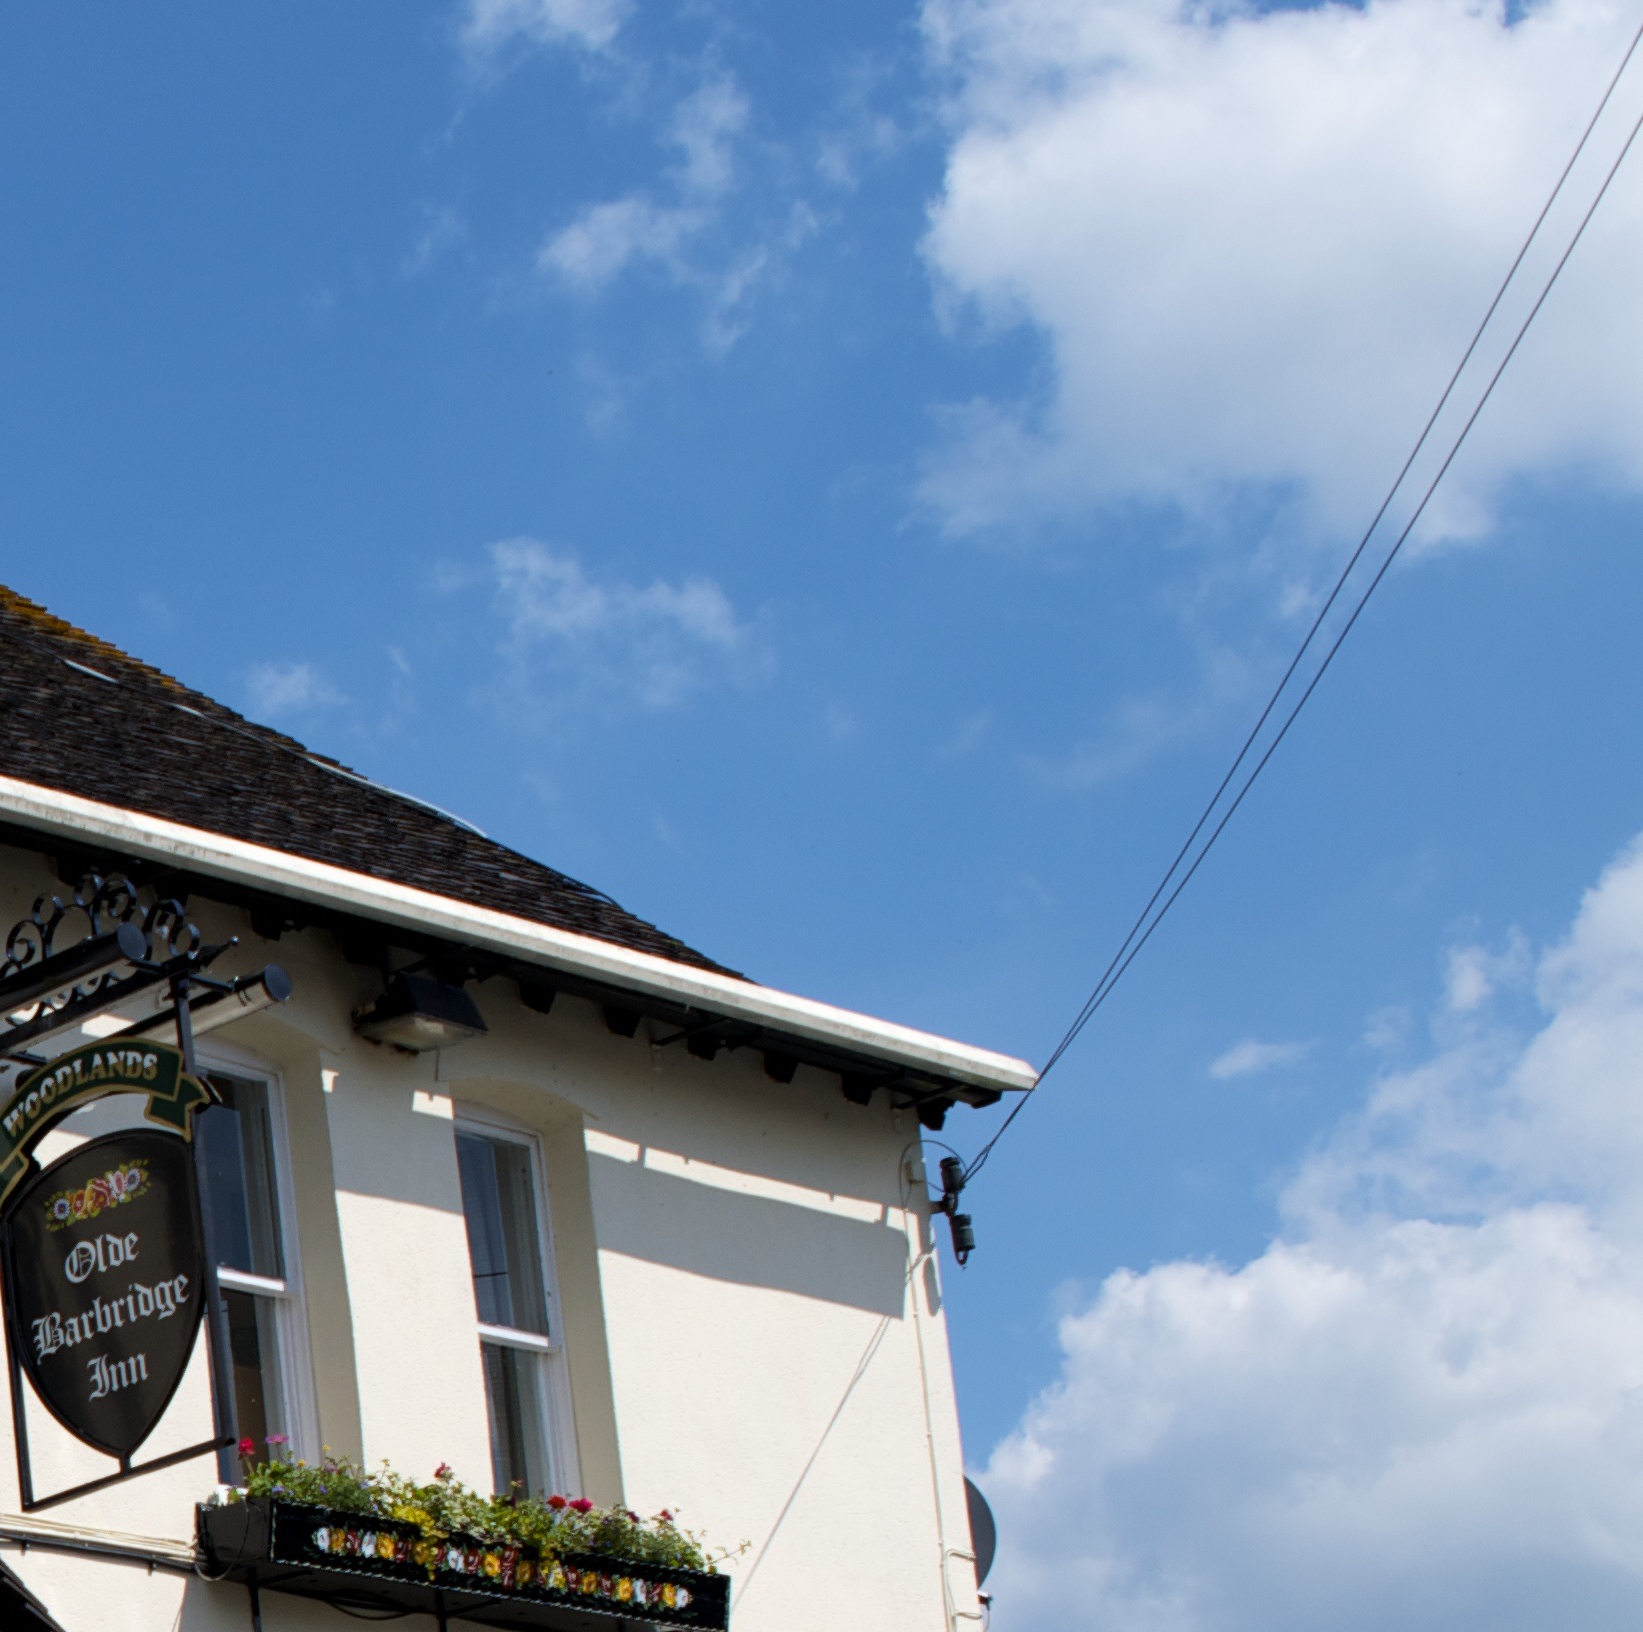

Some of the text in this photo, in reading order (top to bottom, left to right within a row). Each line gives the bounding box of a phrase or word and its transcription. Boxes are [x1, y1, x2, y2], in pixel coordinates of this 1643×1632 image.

[2, 1050, 159, 1138] WOODLANDS
[64, 1231, 139, 1284] Olde
[31, 1273, 190, 1366] Barbridge
[87, 1352, 149, 1400] Inn
